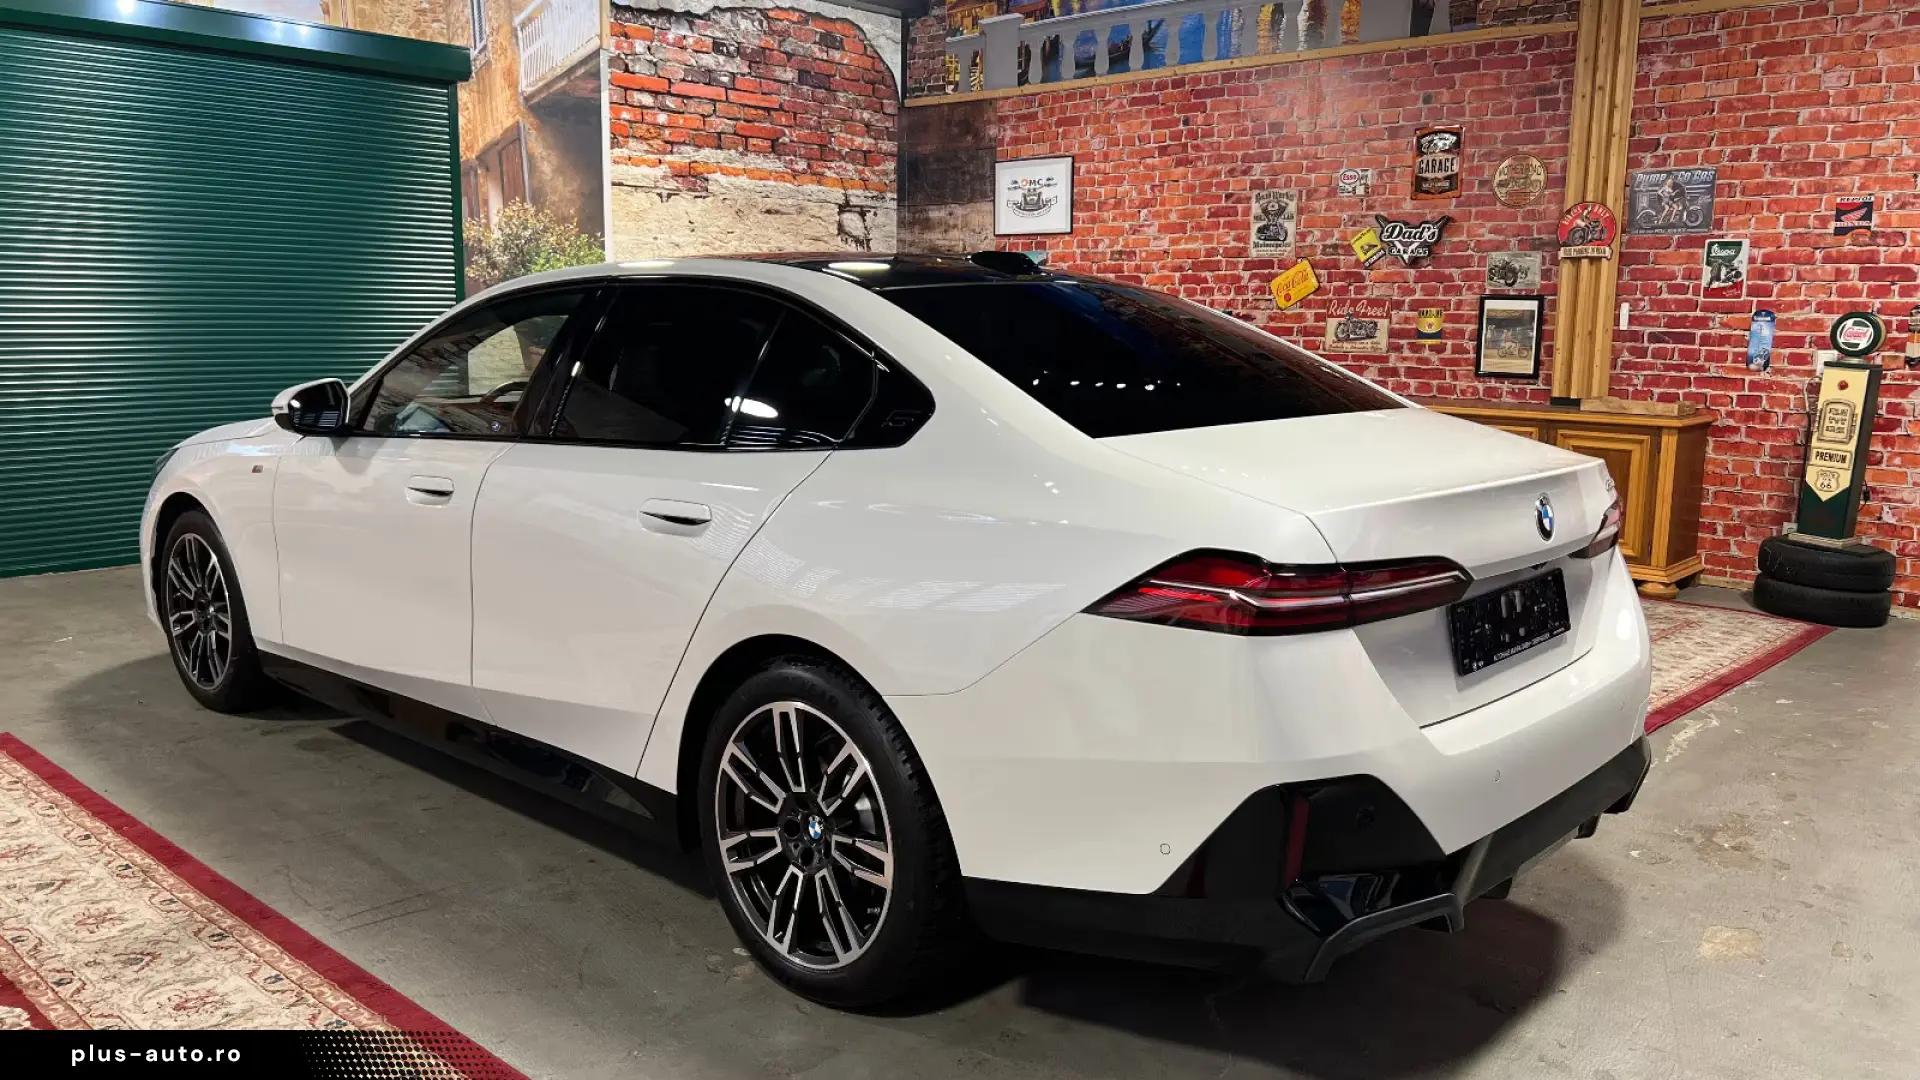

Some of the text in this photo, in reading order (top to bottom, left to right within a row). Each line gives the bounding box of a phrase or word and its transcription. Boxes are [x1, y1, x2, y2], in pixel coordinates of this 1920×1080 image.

[1419, 156, 1457, 175] GARAGE
[1021, 178, 1043, 187] OMC
[1342, 173, 1357, 181] Esso
[1636, 173, 1668, 184] PUMP
[1382, 222, 1439, 242] Dad's
[1710, 243, 1736, 257] Vespa
[1328, 299, 1390, 316] Ride Free!
[1815, 451, 1848, 464] PREMIUM
[1820, 481, 1832, 489] 66
